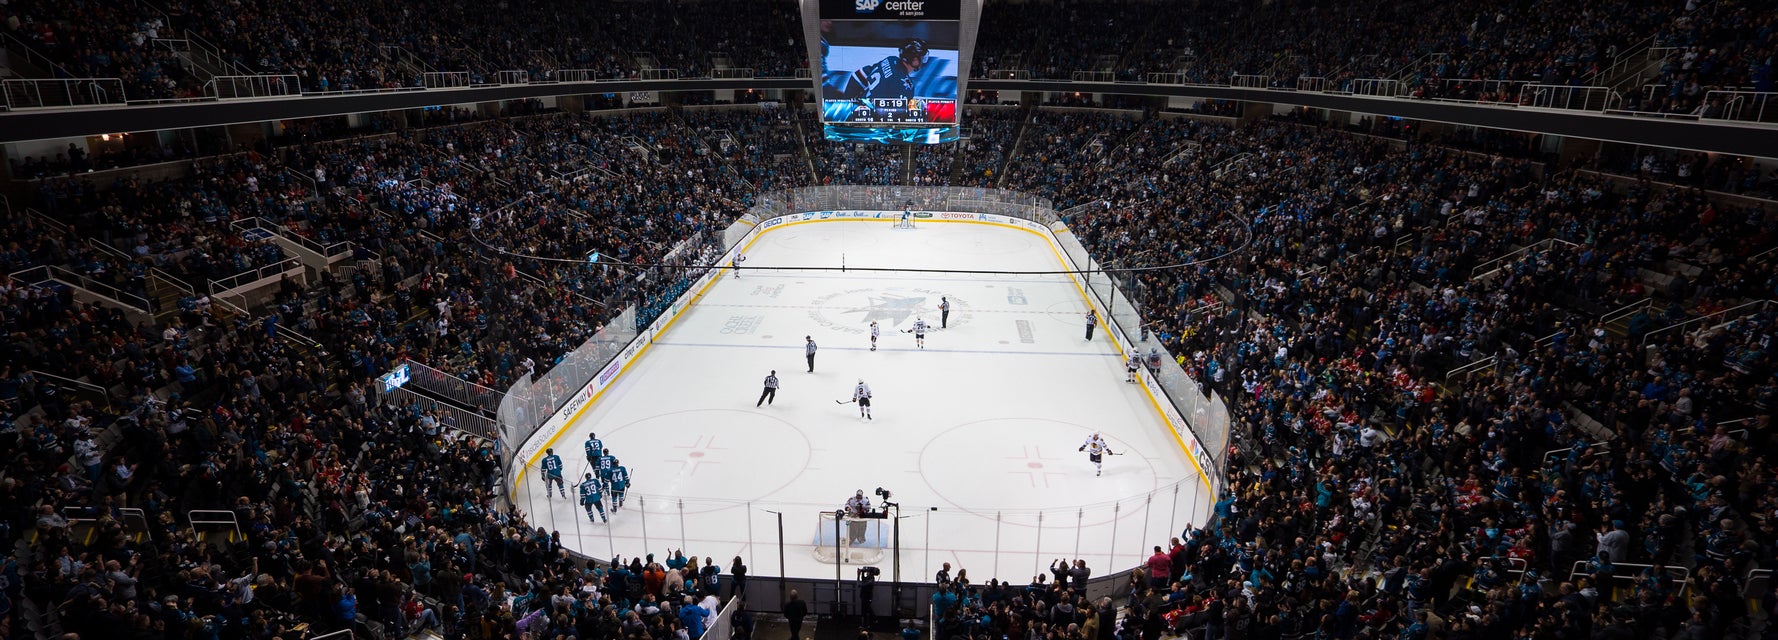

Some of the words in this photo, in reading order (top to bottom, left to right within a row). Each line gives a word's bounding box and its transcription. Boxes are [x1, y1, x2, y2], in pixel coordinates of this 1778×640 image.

[856, 0, 879, 10] SAP
[885, 0, 924, 11] center
[763, 217, 783, 228] GEICO
[858, 387, 864, 395] 2
[563, 392, 587, 421] SAFEWAY
[546, 460, 557, 471] 61
[611, 472, 623, 483] 44
[584, 484, 597, 496] 39
